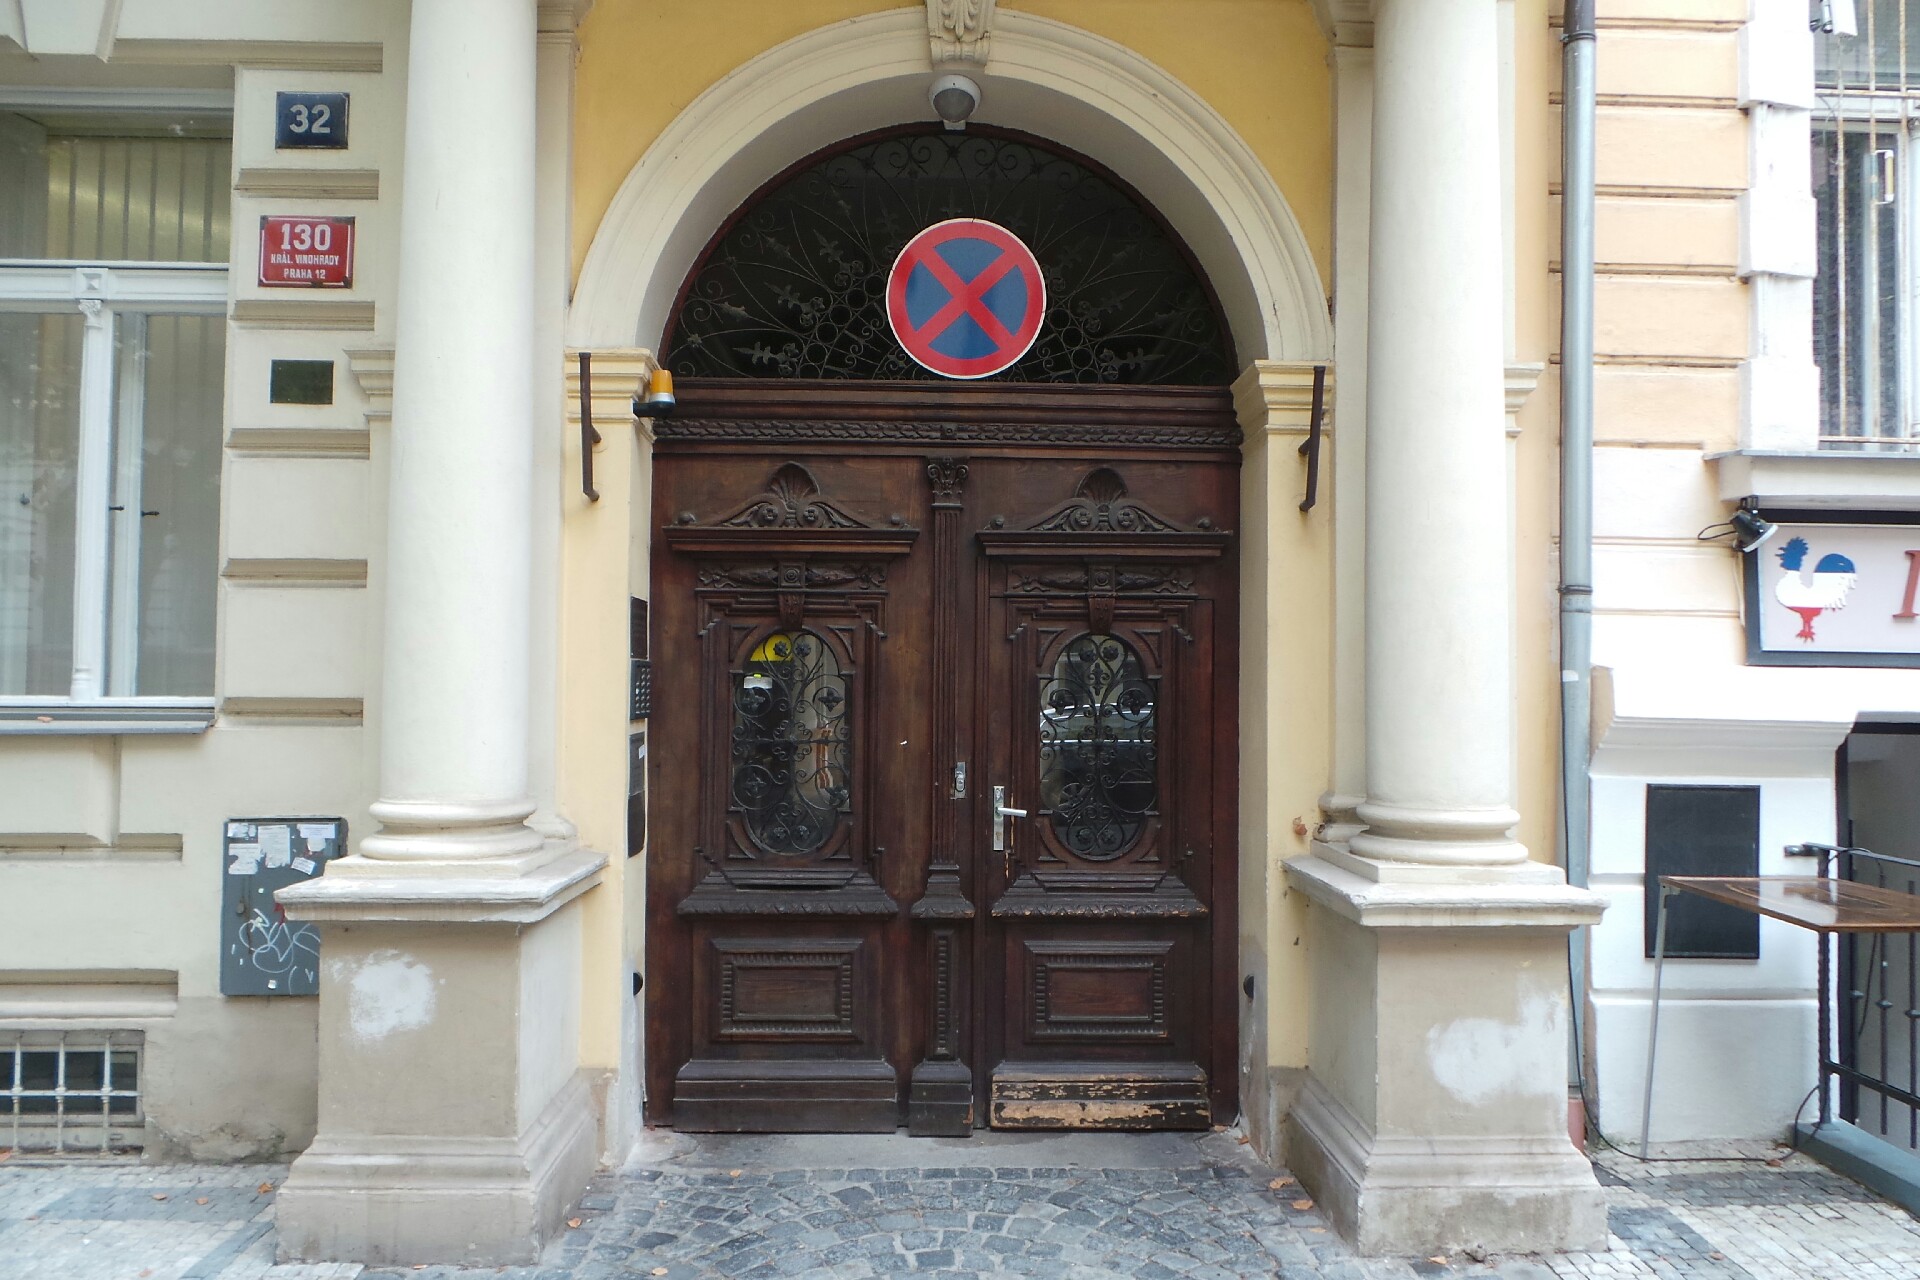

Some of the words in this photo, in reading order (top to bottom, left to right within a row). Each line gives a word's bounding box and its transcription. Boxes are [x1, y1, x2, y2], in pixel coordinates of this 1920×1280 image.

[289, 104, 331, 134] 32
[281, 223, 331, 251] 130
[270, 251, 294, 264] KRÁL.
[295, 254, 340, 266] VINOHRADY
[283, 268, 313, 279] PRAHA
[315, 269, 326, 280] 12
